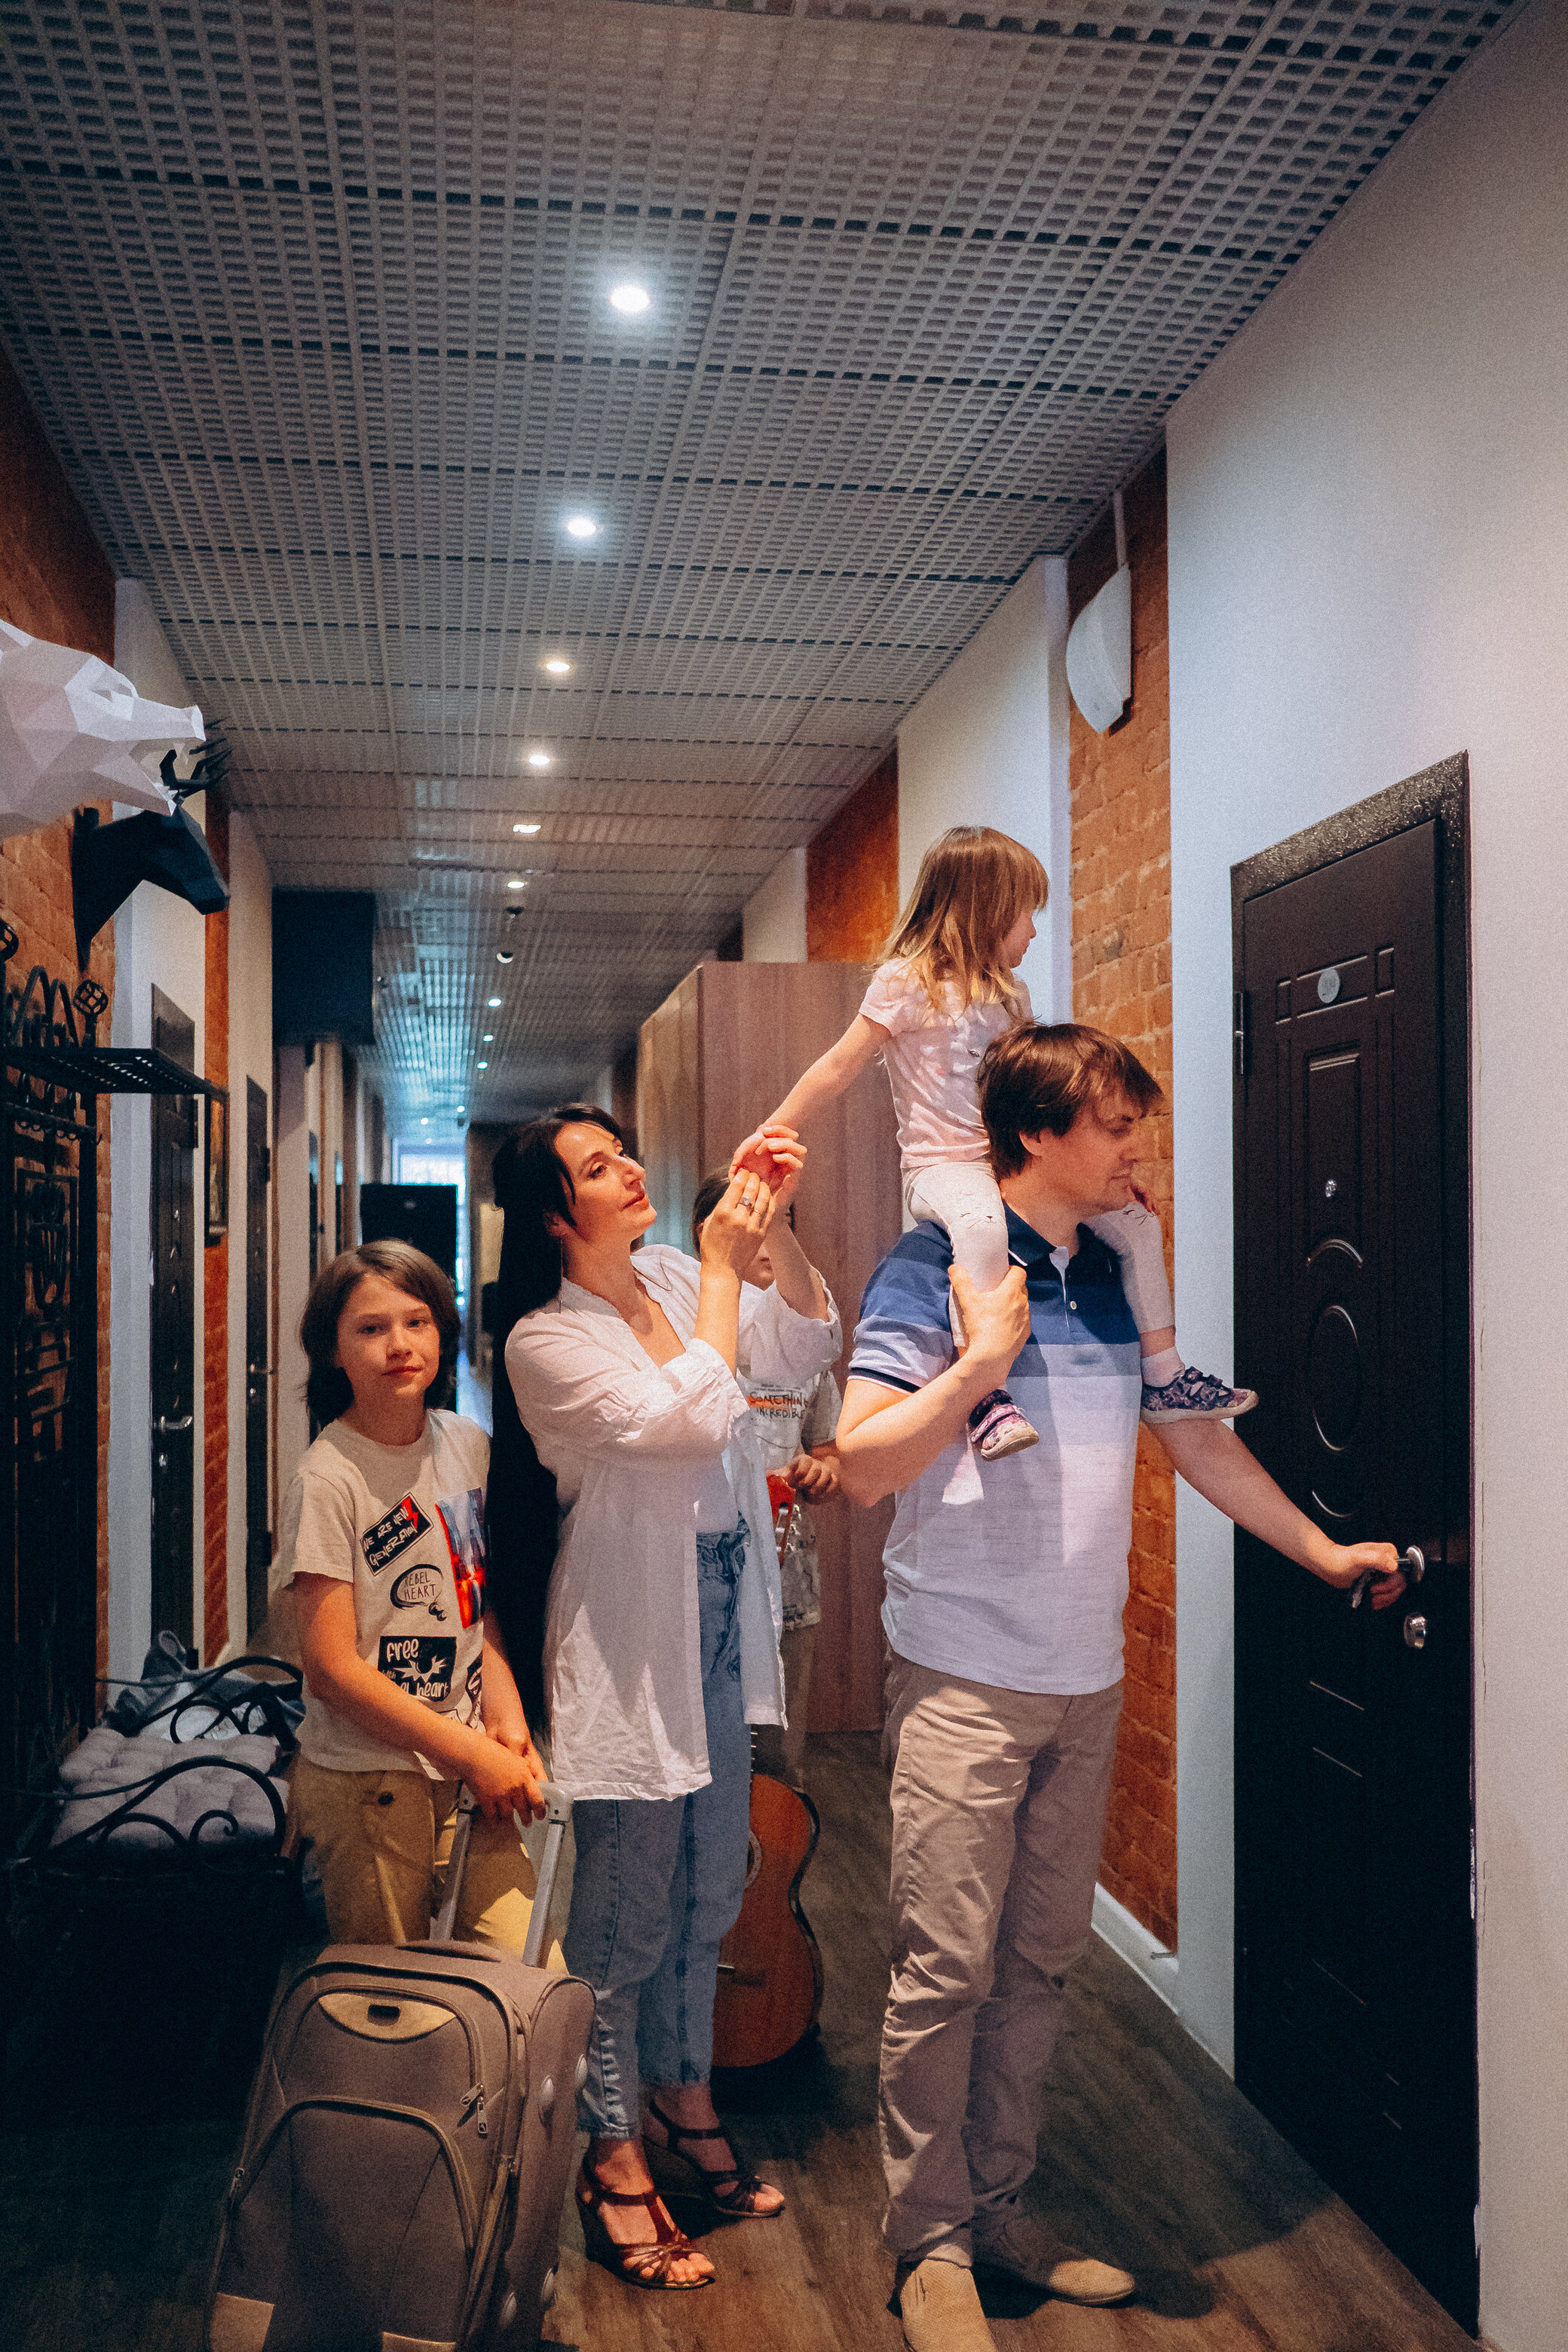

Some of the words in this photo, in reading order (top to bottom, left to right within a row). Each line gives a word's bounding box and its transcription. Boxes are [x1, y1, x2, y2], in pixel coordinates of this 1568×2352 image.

[363, 1536, 375, 1552] WE
[378, 1521, 393, 1539] ARE
[393, 1505, 409, 1526] NEW
[369, 1521, 418, 1566] GENERATION
[404, 1571, 430, 1587] REBEL
[404, 1584, 436, 1600] HEART
[386, 1638, 419, 1663] free
[415, 1681, 449, 1698] heart
